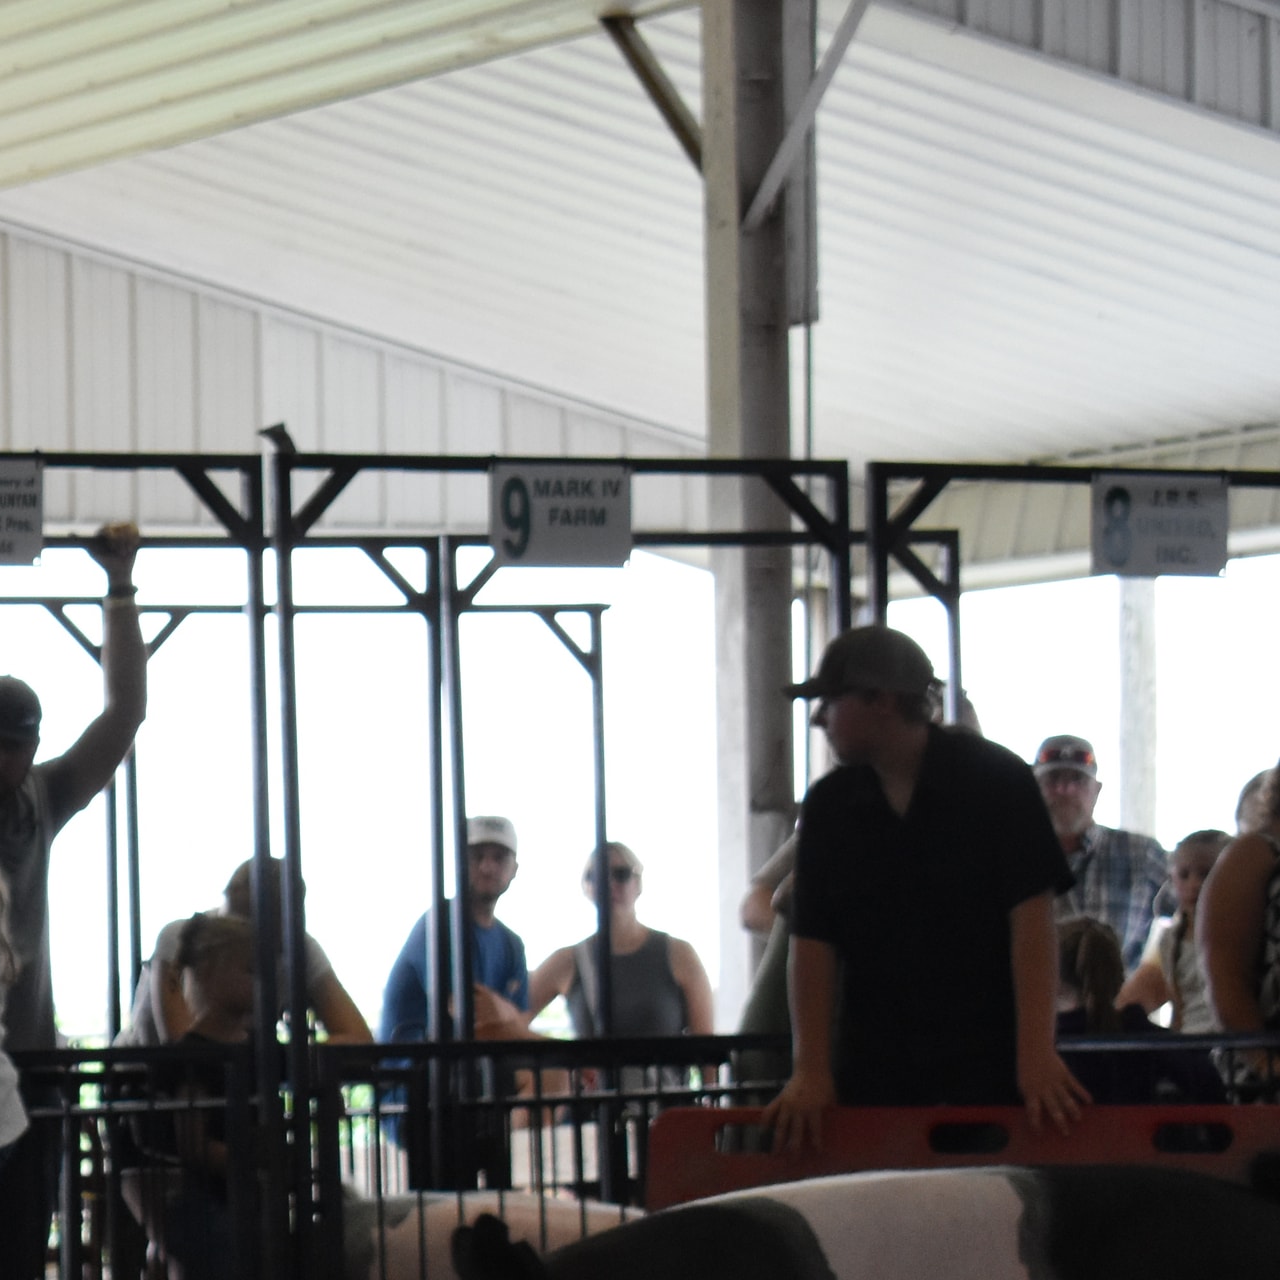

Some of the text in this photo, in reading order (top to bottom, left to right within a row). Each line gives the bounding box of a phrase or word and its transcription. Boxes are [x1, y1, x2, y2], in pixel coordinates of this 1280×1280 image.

[534, 478, 622, 498] MARK IV
[502, 474, 531, 560] 9
[549, 507, 606, 527] FARM
[1103, 485, 1132, 567] 8
[1155, 545, 1197, 565] INC.
